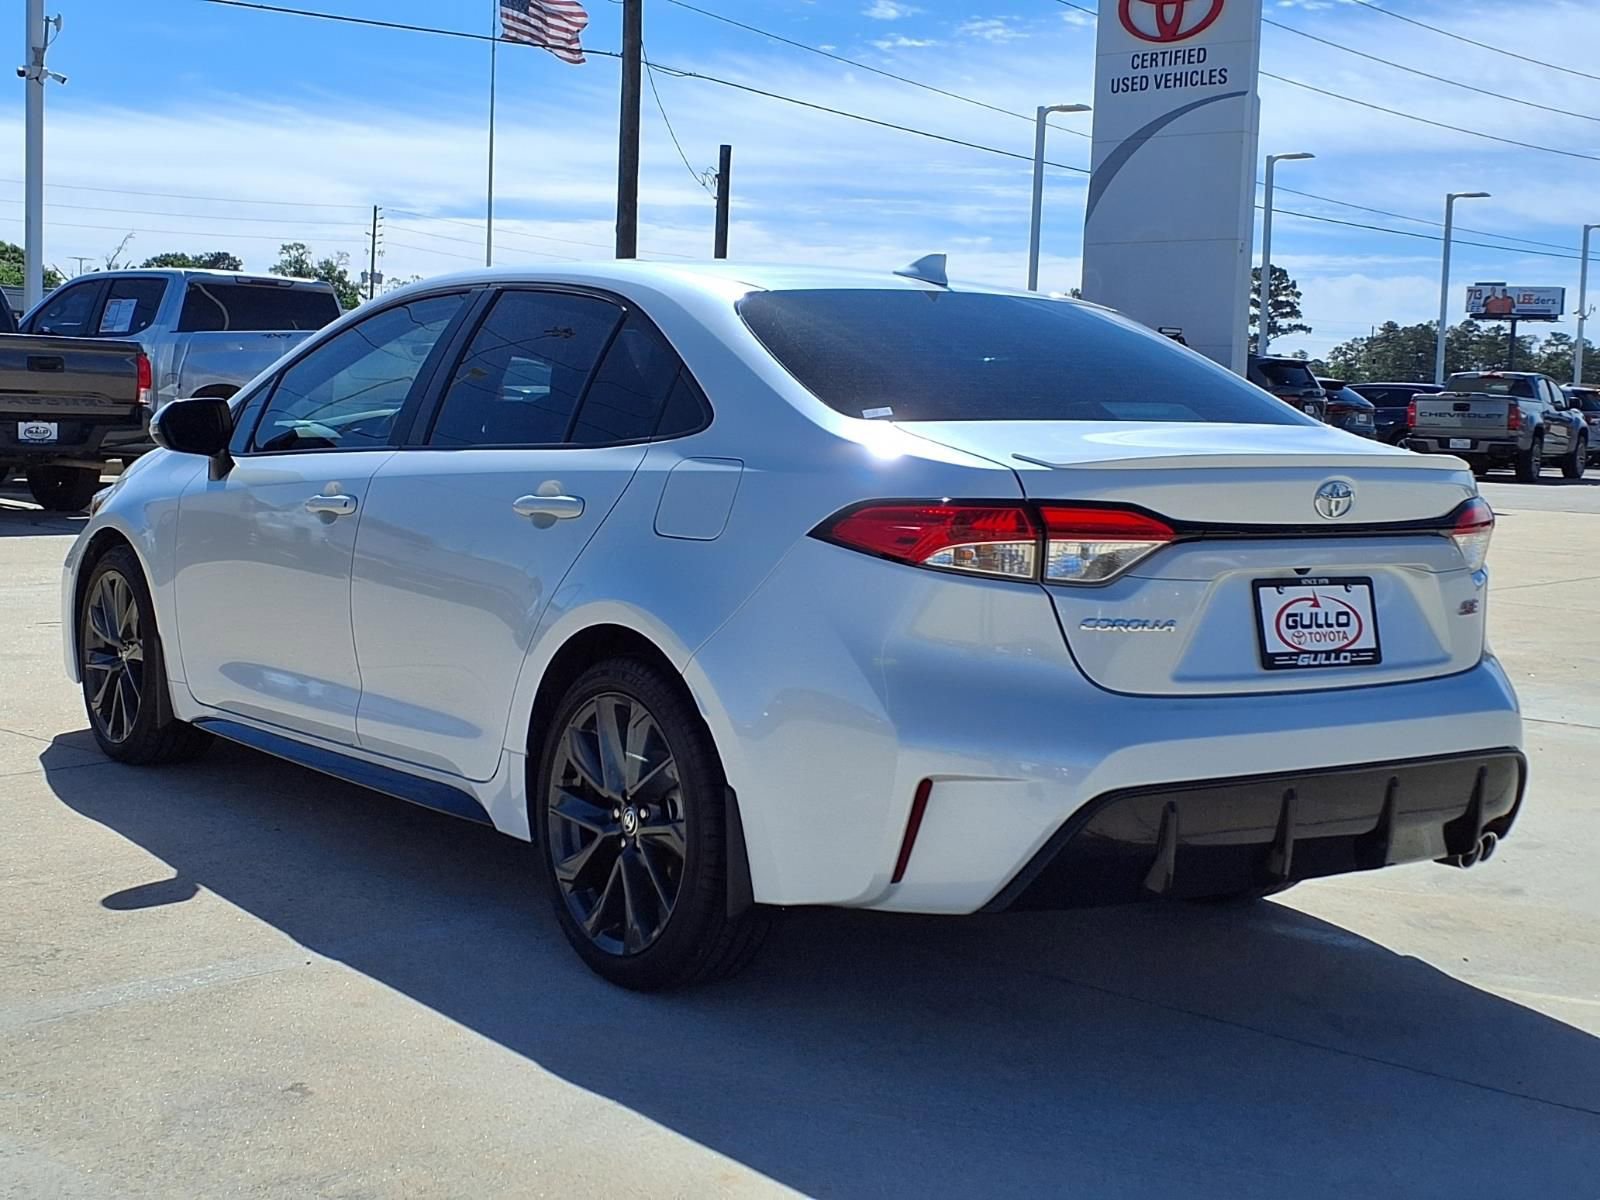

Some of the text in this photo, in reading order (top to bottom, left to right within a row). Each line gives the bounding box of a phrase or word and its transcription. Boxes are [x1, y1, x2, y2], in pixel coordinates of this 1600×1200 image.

[1131, 47, 1207, 70] CERTIFIED
[1111, 68, 1228, 94] USED VEHICLES
[1419, 411, 1505, 419] CHEVROLET
[1080, 618, 1177, 632] COROLLA
[1285, 611, 1351, 630] GULLO
[1308, 630, 1350, 643] TOYOTA
[1296, 652, 1352, 665] GULLO
